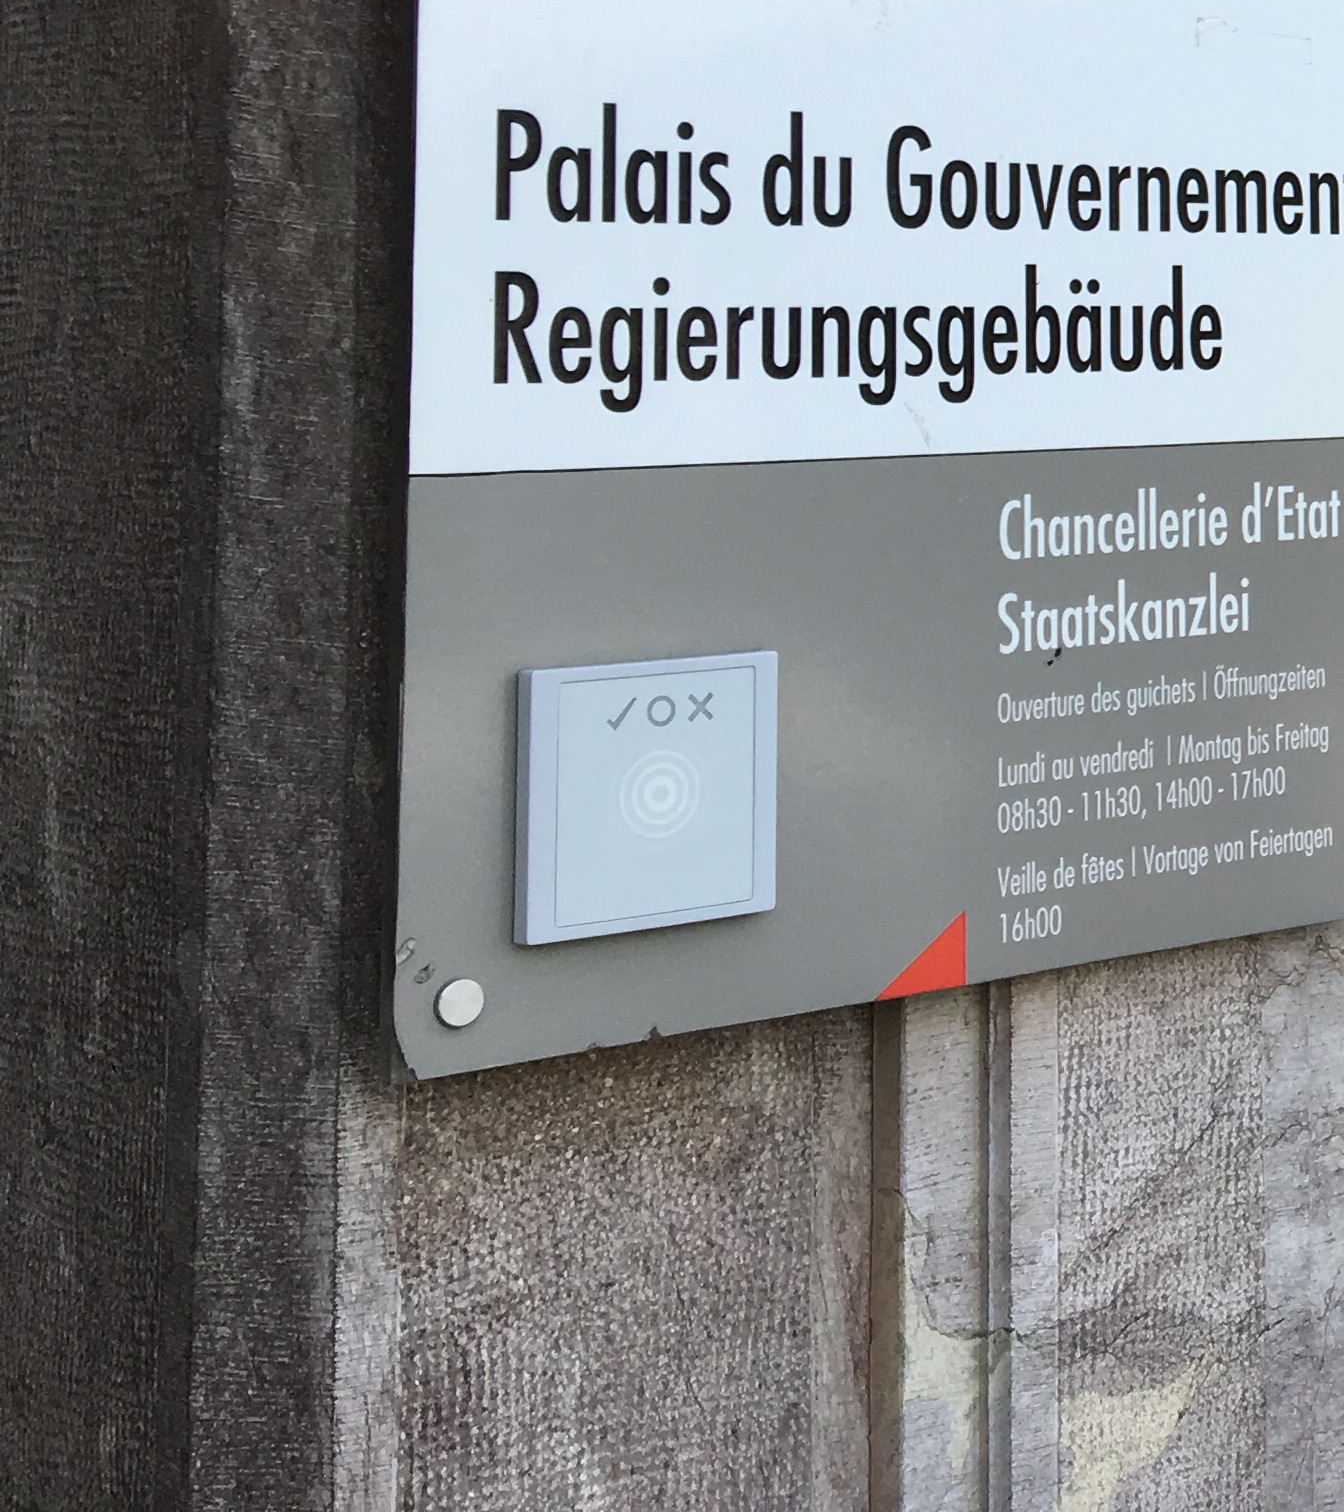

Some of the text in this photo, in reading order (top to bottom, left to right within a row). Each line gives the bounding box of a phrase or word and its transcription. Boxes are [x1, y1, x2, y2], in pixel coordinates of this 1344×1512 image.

[494, 101, 733, 227] Palais
[761, 109, 854, 229] du
[492, 262, 1224, 414] Regierungsgebäude
[998, 485, 1230, 562] Chancellerie
[996, 570, 1251, 656] Staatskanzlei
[997, 691, 1085, 724] Ouverture
[1090, 681, 1121, 714] des
[1126, 674, 1196, 717] guichets
[1213, 663, 1326, 701] Öffnungzeiten
[998, 750, 1046, 788] Lundi
[1051, 757, 1074, 781] au
[1079, 737, 1154, 777] vendredi
[1178, 734, 1242, 765] Montag
[1247, 725, 1270, 756] bis
[1275, 722, 1329, 753] Freitag
[997, 795, 1062, 834] 08h30
[1081, 784, 1147, 822] 11h30,
[1155, 775, 1213, 812] 14h00
[1230, 765, 1286, 801] 17h00
[997, 860, 1047, 898] Veille
[1053, 856, 1076, 890] de
[1080, 852, 1125, 885] fêtes
[1142, 844, 1209, 876] Vortage
[1213, 840, 1244, 864] von
[1250, 826, 1334, 859] Feiertagen
[999, 904, 1062, 944] 16h00
